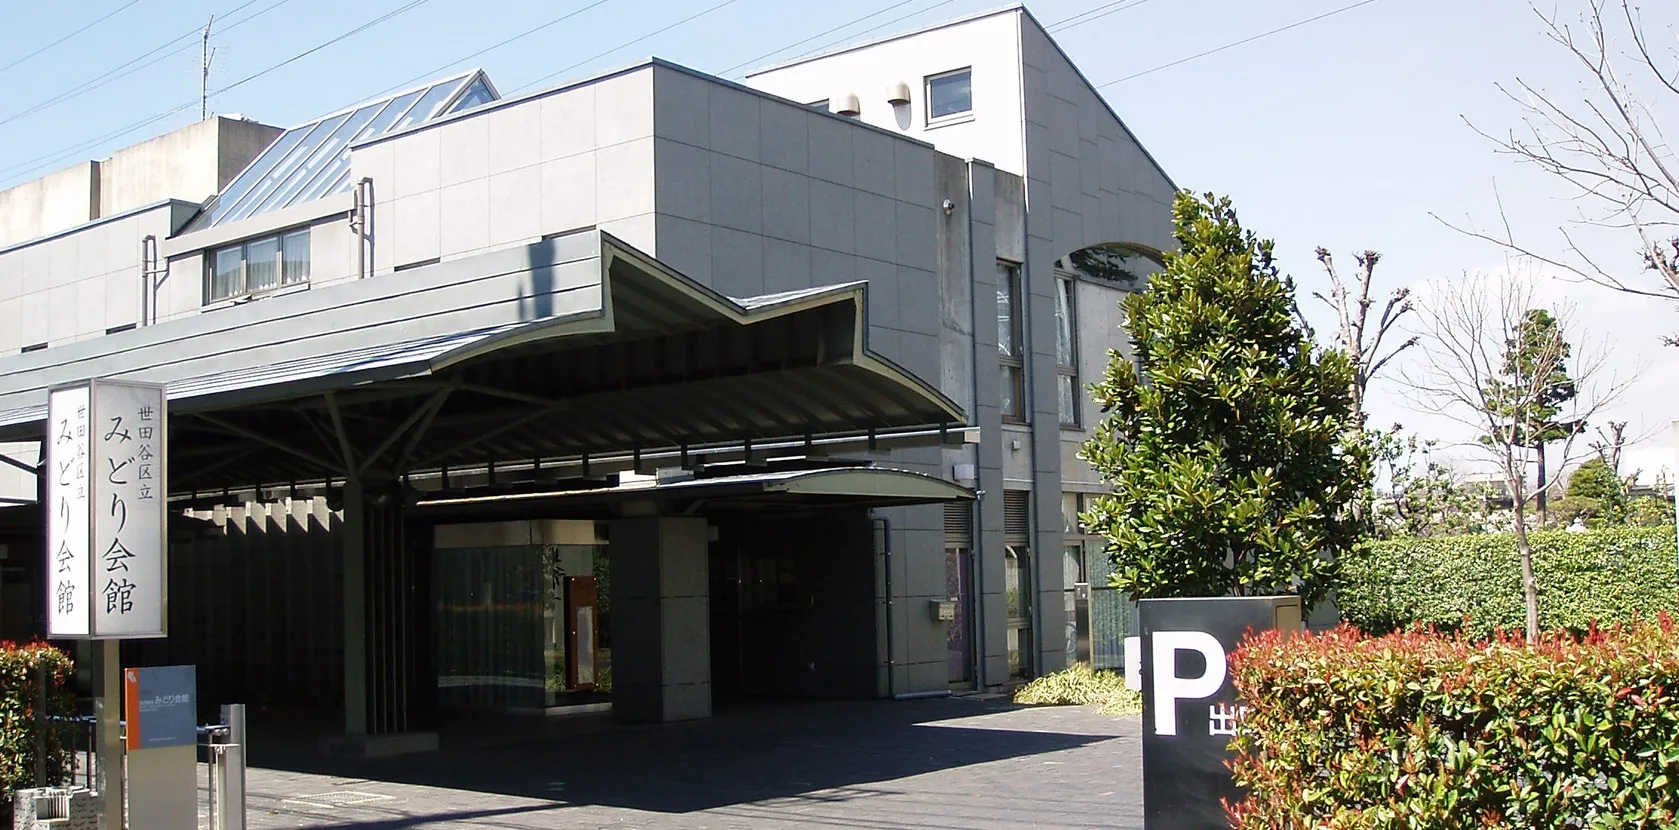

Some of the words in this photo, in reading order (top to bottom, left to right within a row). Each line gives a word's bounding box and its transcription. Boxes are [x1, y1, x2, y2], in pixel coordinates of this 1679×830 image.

[77, 405, 86, 499] 世田谷区立
[137, 406, 154, 500] 世田谷区立
[56, 418, 75, 616] みどり会館
[102, 416, 136, 615] みどり会館
[1152, 631, 1227, 736] P
